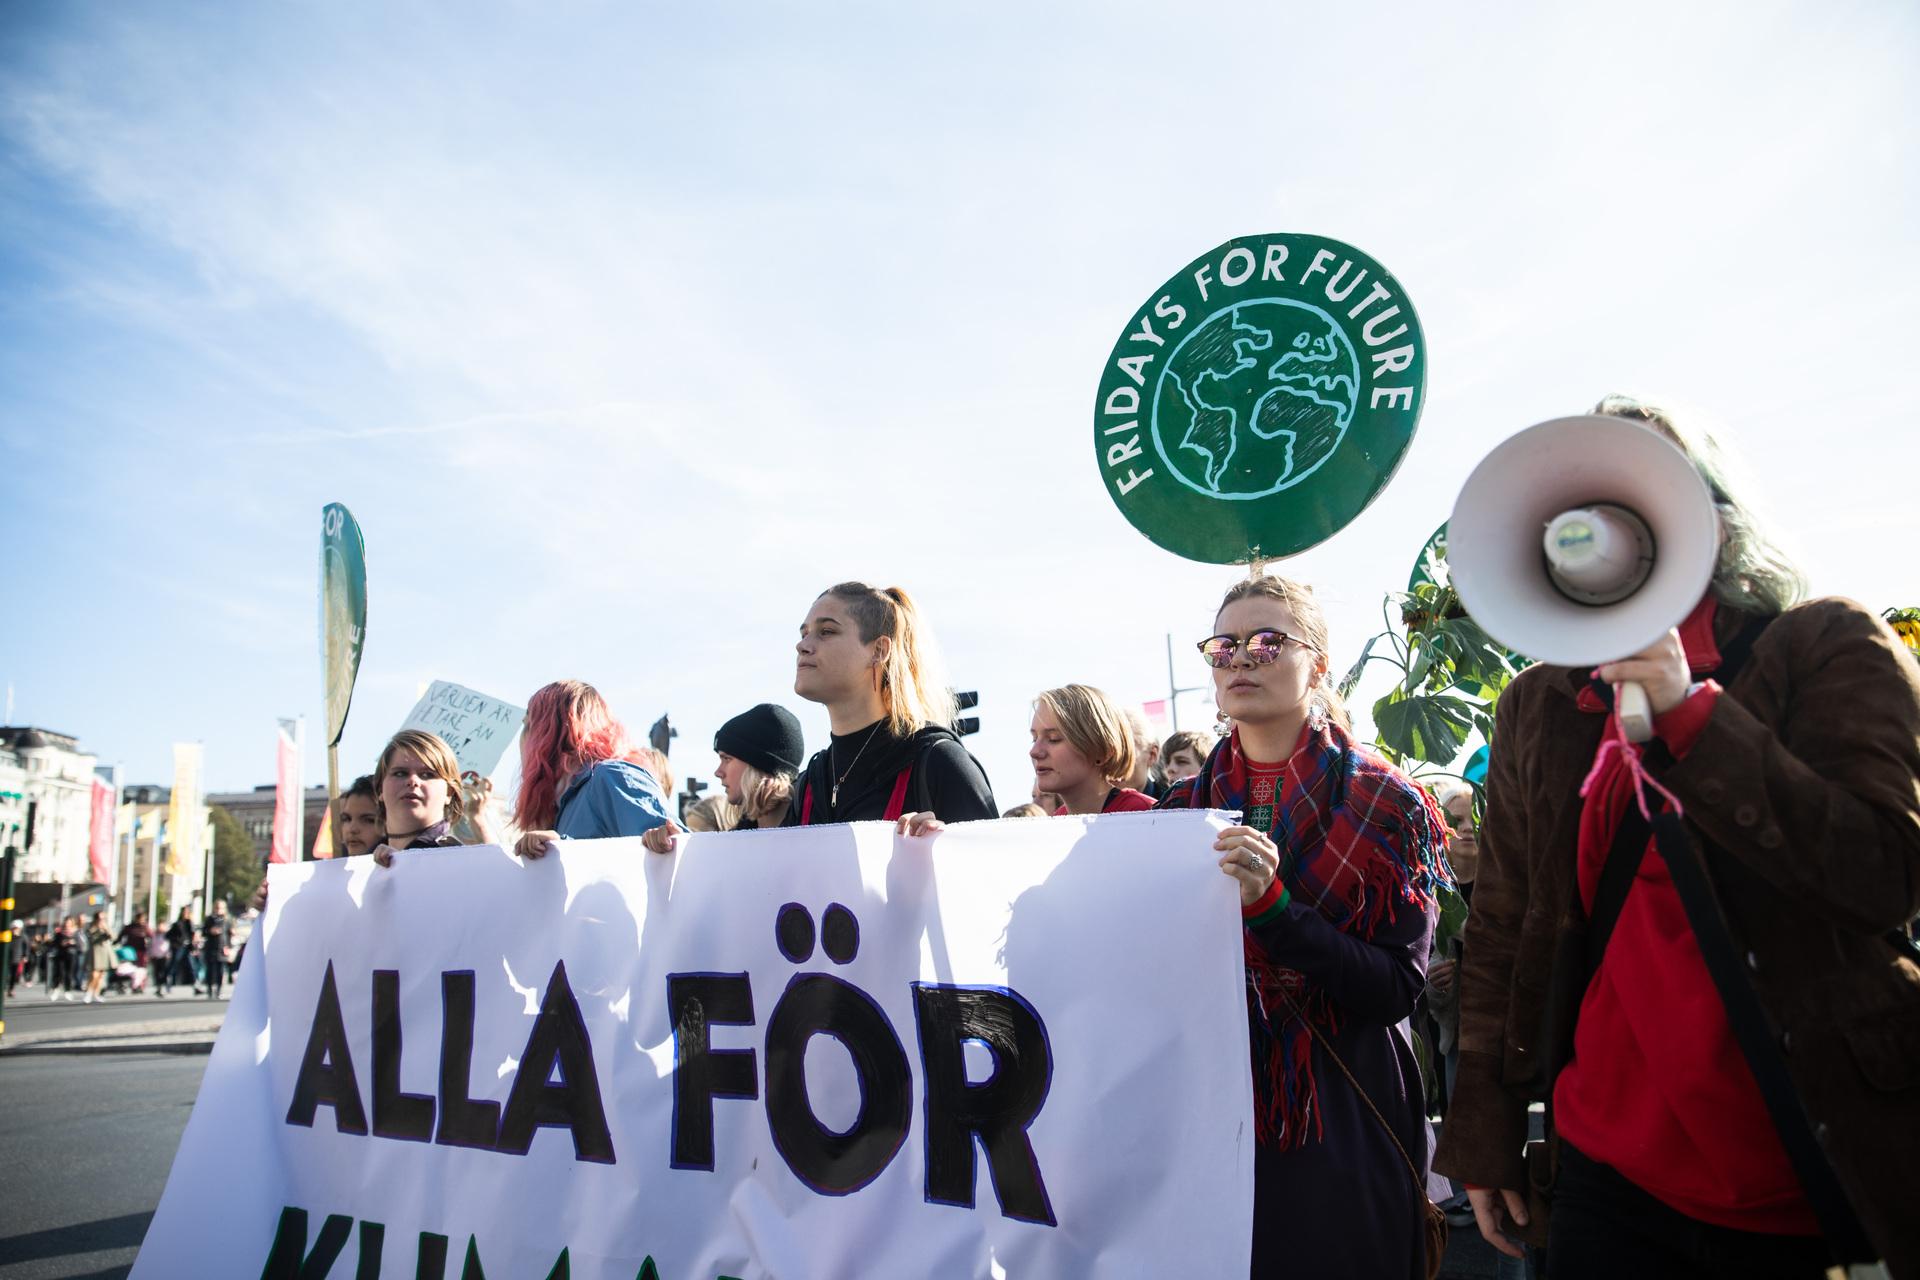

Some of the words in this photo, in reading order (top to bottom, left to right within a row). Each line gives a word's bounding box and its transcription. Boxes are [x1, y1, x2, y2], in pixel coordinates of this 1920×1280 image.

[1104, 295, 1187, 496] FRIDAYS
[1194, 244, 1289, 302] FOR
[1299, 248, 1415, 411] FUTURE
[322, 507, 344, 540] OR
[430, 685, 488, 715] VÄRLDEN
[488, 704, 512, 723] ÄR
[470, 722, 494, 740] ÄN
[285, 959, 616, 1164] ALLA
[666, 902, 1058, 1227] FÖR
